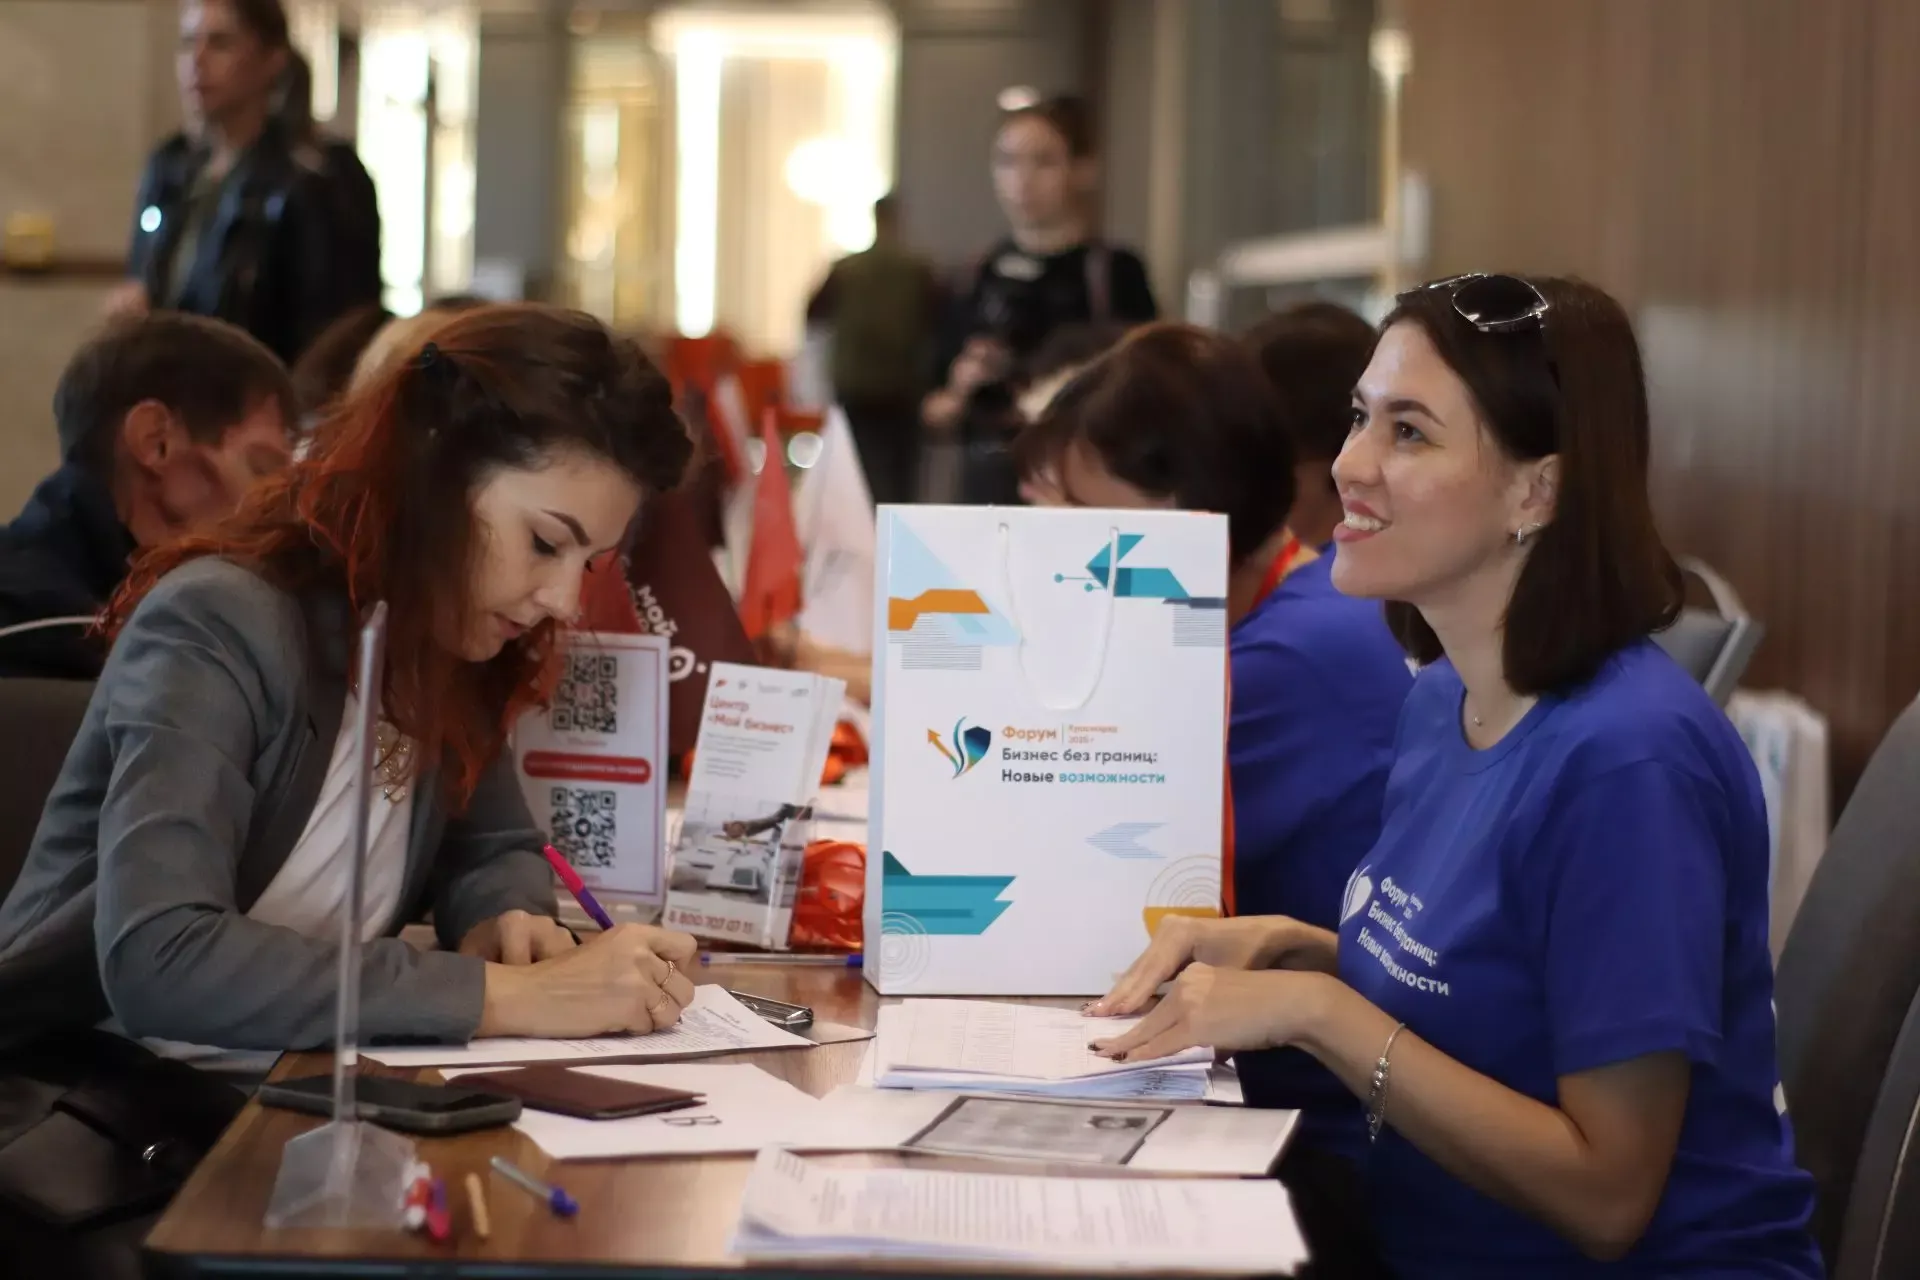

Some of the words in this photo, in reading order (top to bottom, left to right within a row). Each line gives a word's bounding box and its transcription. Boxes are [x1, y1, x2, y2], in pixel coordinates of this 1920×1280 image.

[710, 695, 749, 712] Центр
[1002, 725, 1057, 743] Форум
[1002, 748, 1058, 762] Бизнес
[1063, 749, 1090, 762] без
[1095, 751, 1158, 765] границ:
[1001, 769, 1054, 783] Новые
[1059, 771, 1165, 783] возможности
[1380, 876, 1409, 908] Форум
[1368, 900, 1397, 933] Бизнес
[1357, 926, 1384, 958] Новые
